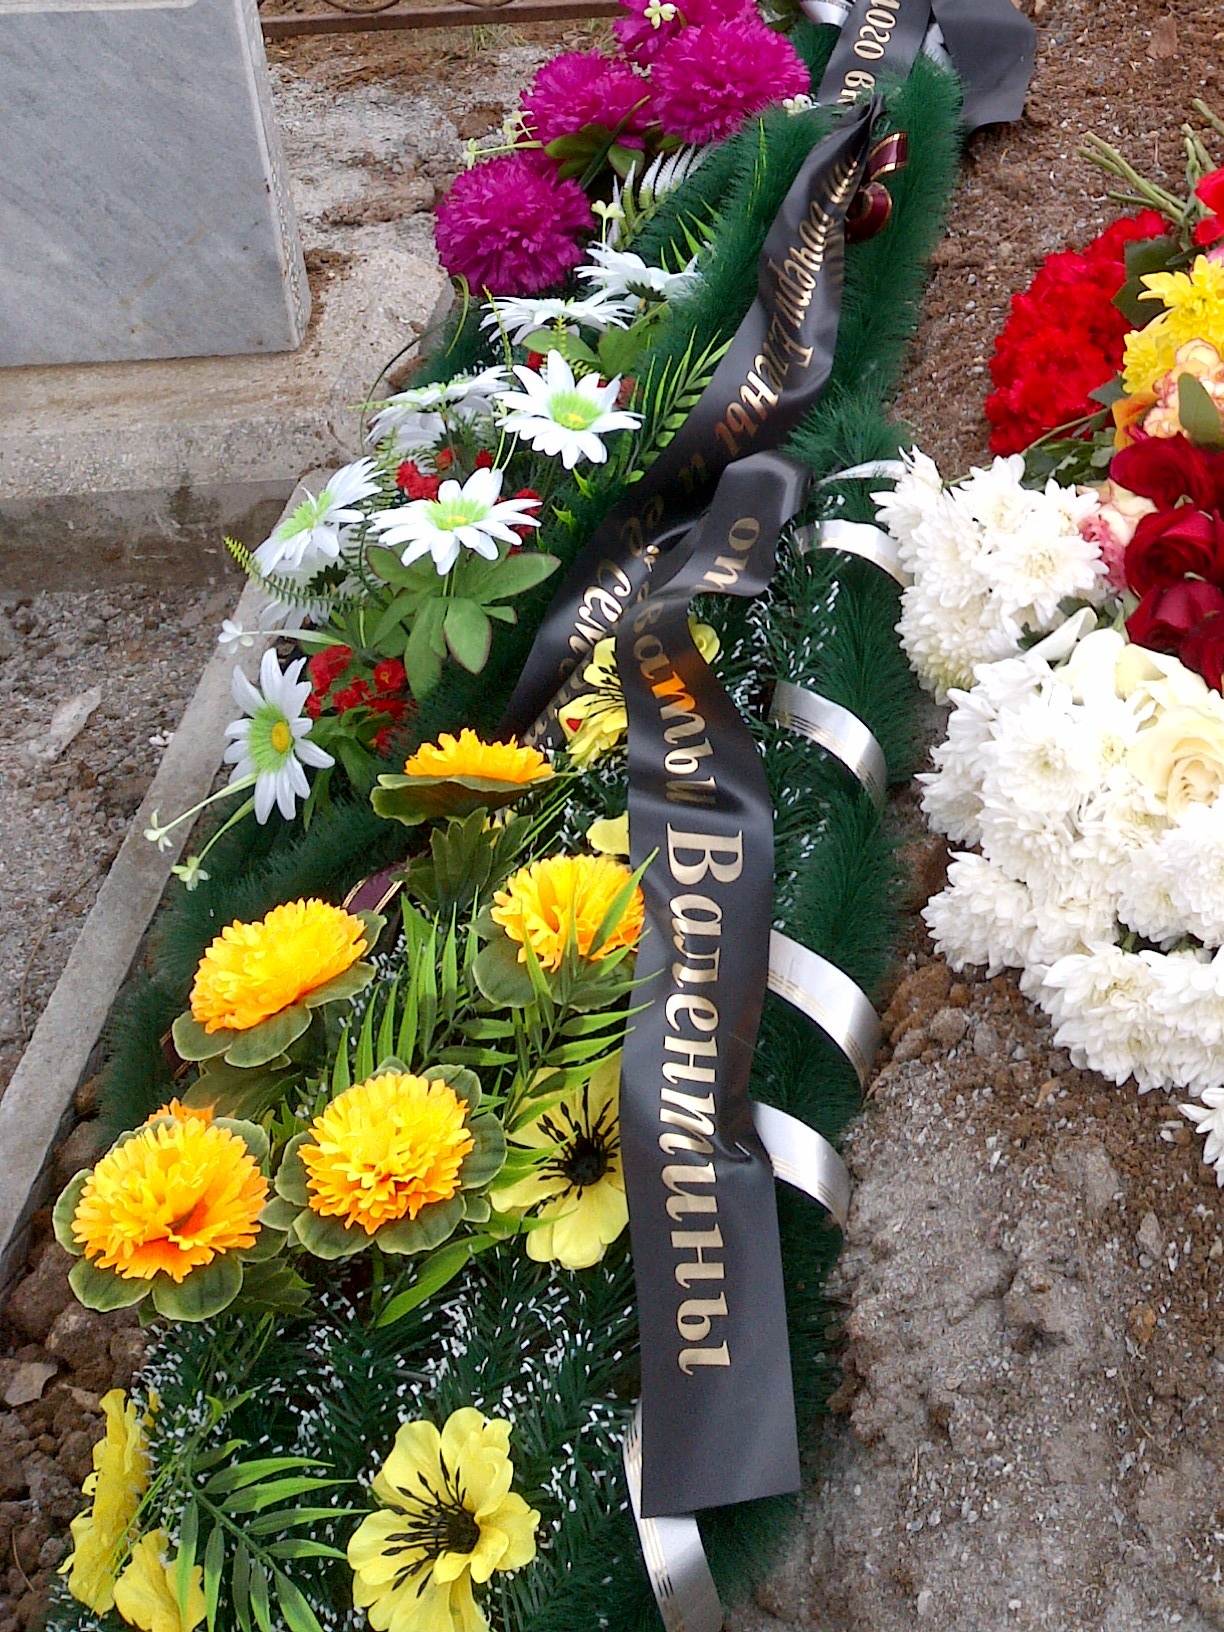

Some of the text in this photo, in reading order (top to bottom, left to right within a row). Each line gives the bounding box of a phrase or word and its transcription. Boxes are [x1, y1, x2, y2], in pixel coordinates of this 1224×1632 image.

[714, 312, 814, 458] Елены
[633, 599, 718, 806] ватьи
[657, 822, 745, 1377] Валентины
